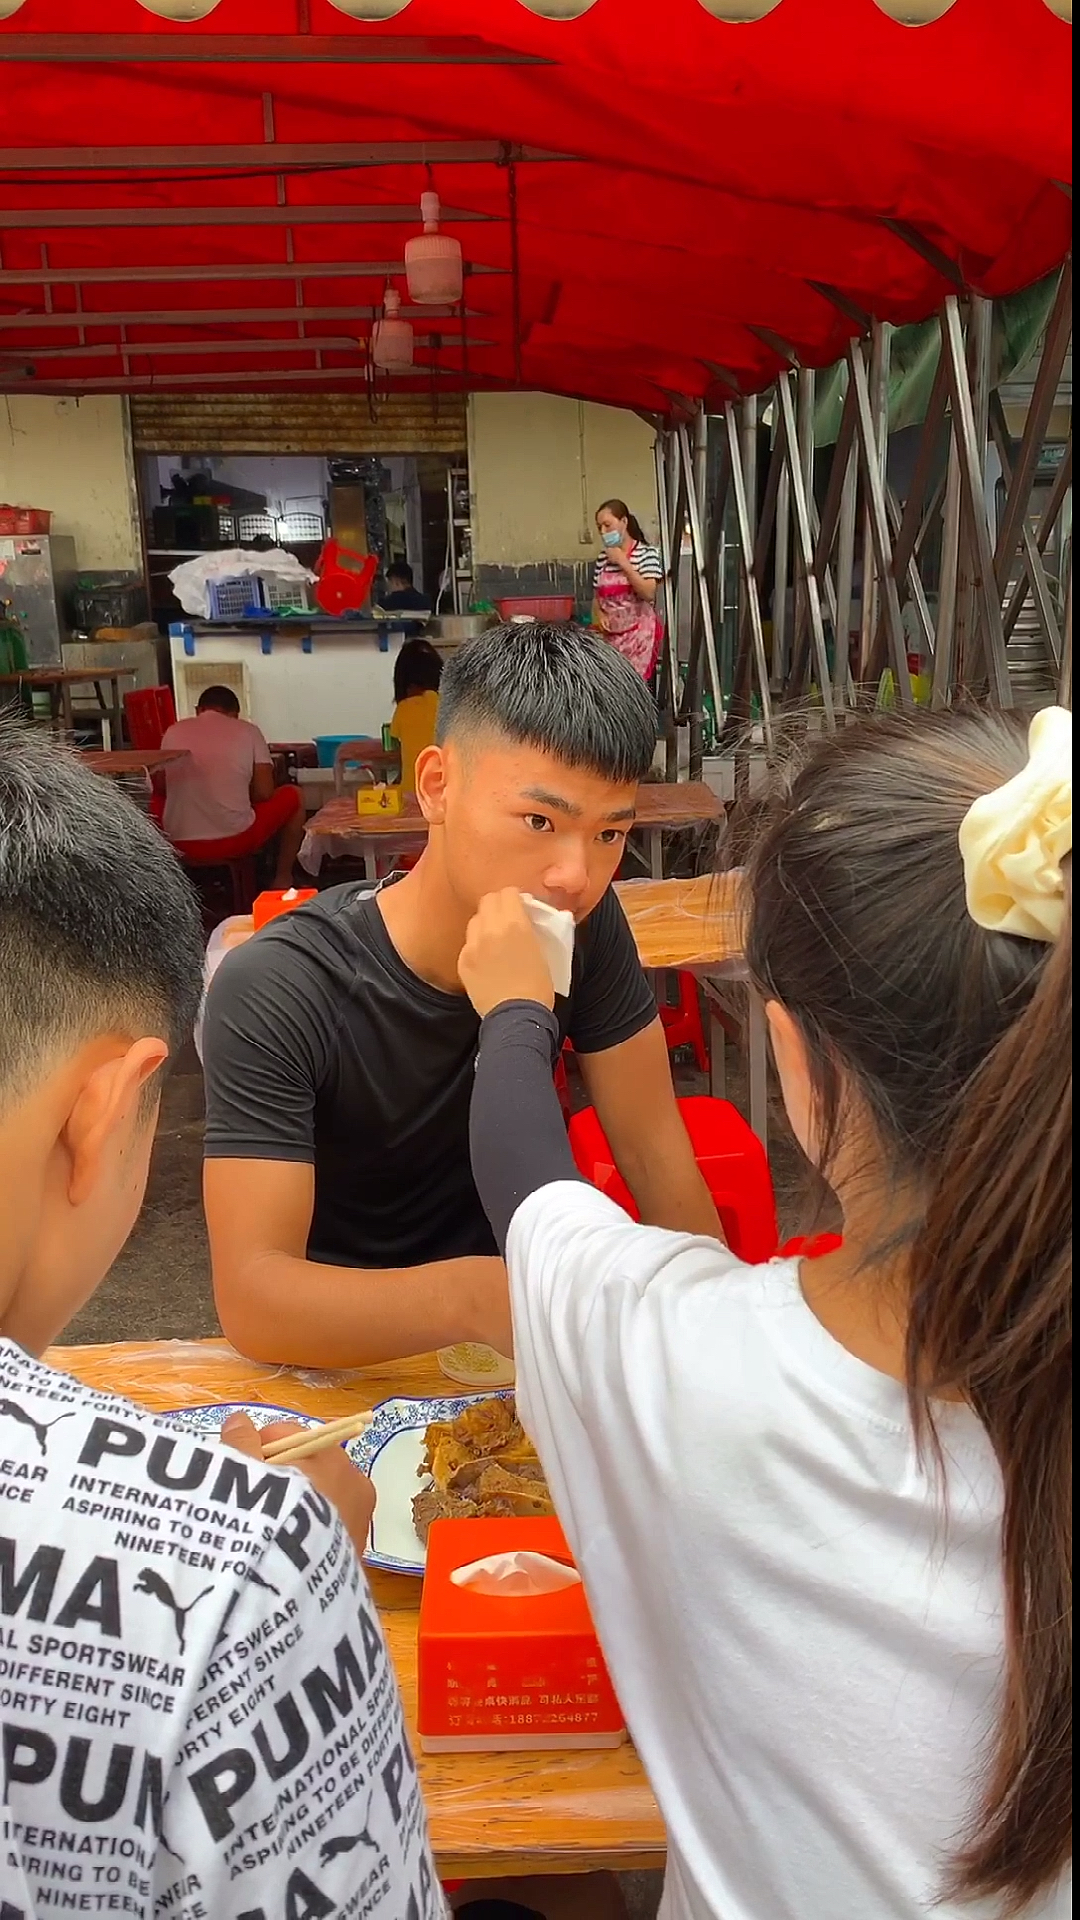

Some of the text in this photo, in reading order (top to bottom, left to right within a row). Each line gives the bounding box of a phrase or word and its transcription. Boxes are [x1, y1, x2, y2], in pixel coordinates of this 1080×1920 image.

[28, 1373, 52, 1387] TO
[82, 1400, 147, 1421] FORTY
[61, 1496, 161, 1531] ASPIRING
[169, 1519, 193, 1539] TO
[199, 1530, 226, 1550] BE
[69, 1473, 254, 1534] INTERNATIONAL
[114, 1530, 216, 1571] NINETEEN
[27, 1633, 186, 1688] SPORTSWEAR
[254, 1623, 304, 1673] SINCE
[63, 1702, 132, 1729] EIGHT
[121, 1683, 176, 1714] SINCE
[188, 1603, 383, 1843] PUMA
[228, 1674, 275, 1729] EIGHT
[311, 1776, 337, 1805] TO
[340, 1750, 361, 1778] BE
[287, 1772, 366, 1861] NINETEEN
[92, 1865, 121, 1883] TO
[128, 1871, 150, 1897] BE
